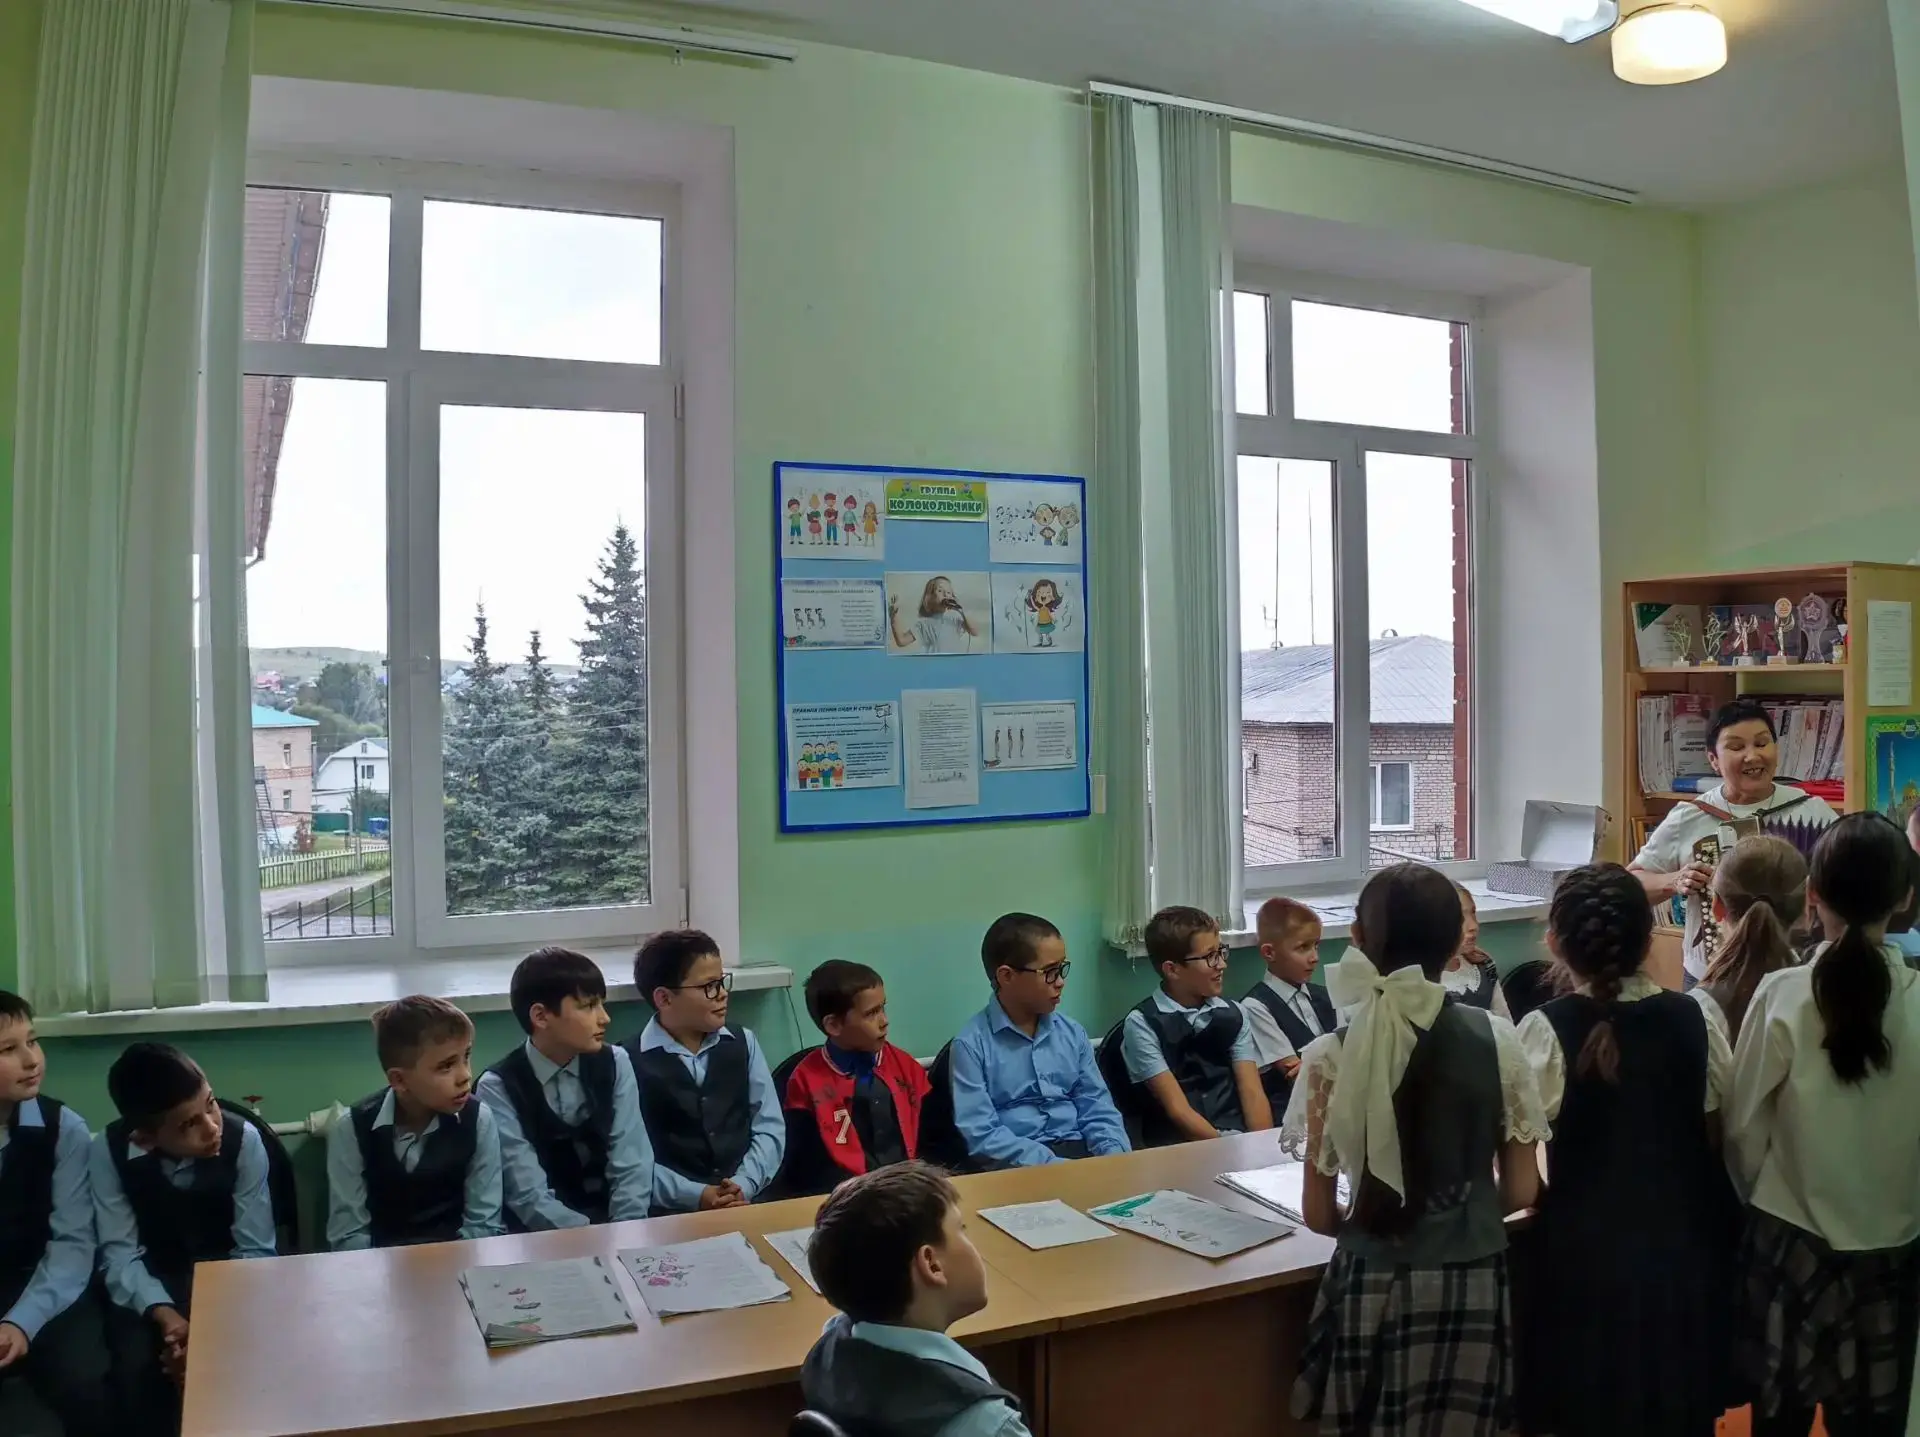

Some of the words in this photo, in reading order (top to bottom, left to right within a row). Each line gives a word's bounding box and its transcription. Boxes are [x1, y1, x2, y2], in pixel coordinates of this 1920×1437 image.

[920, 486, 956, 495] ГРУППА
[890, 499, 983, 512] КОЛОКОЛЬЧИКИ
[833, 1108, 851, 1144] 7
